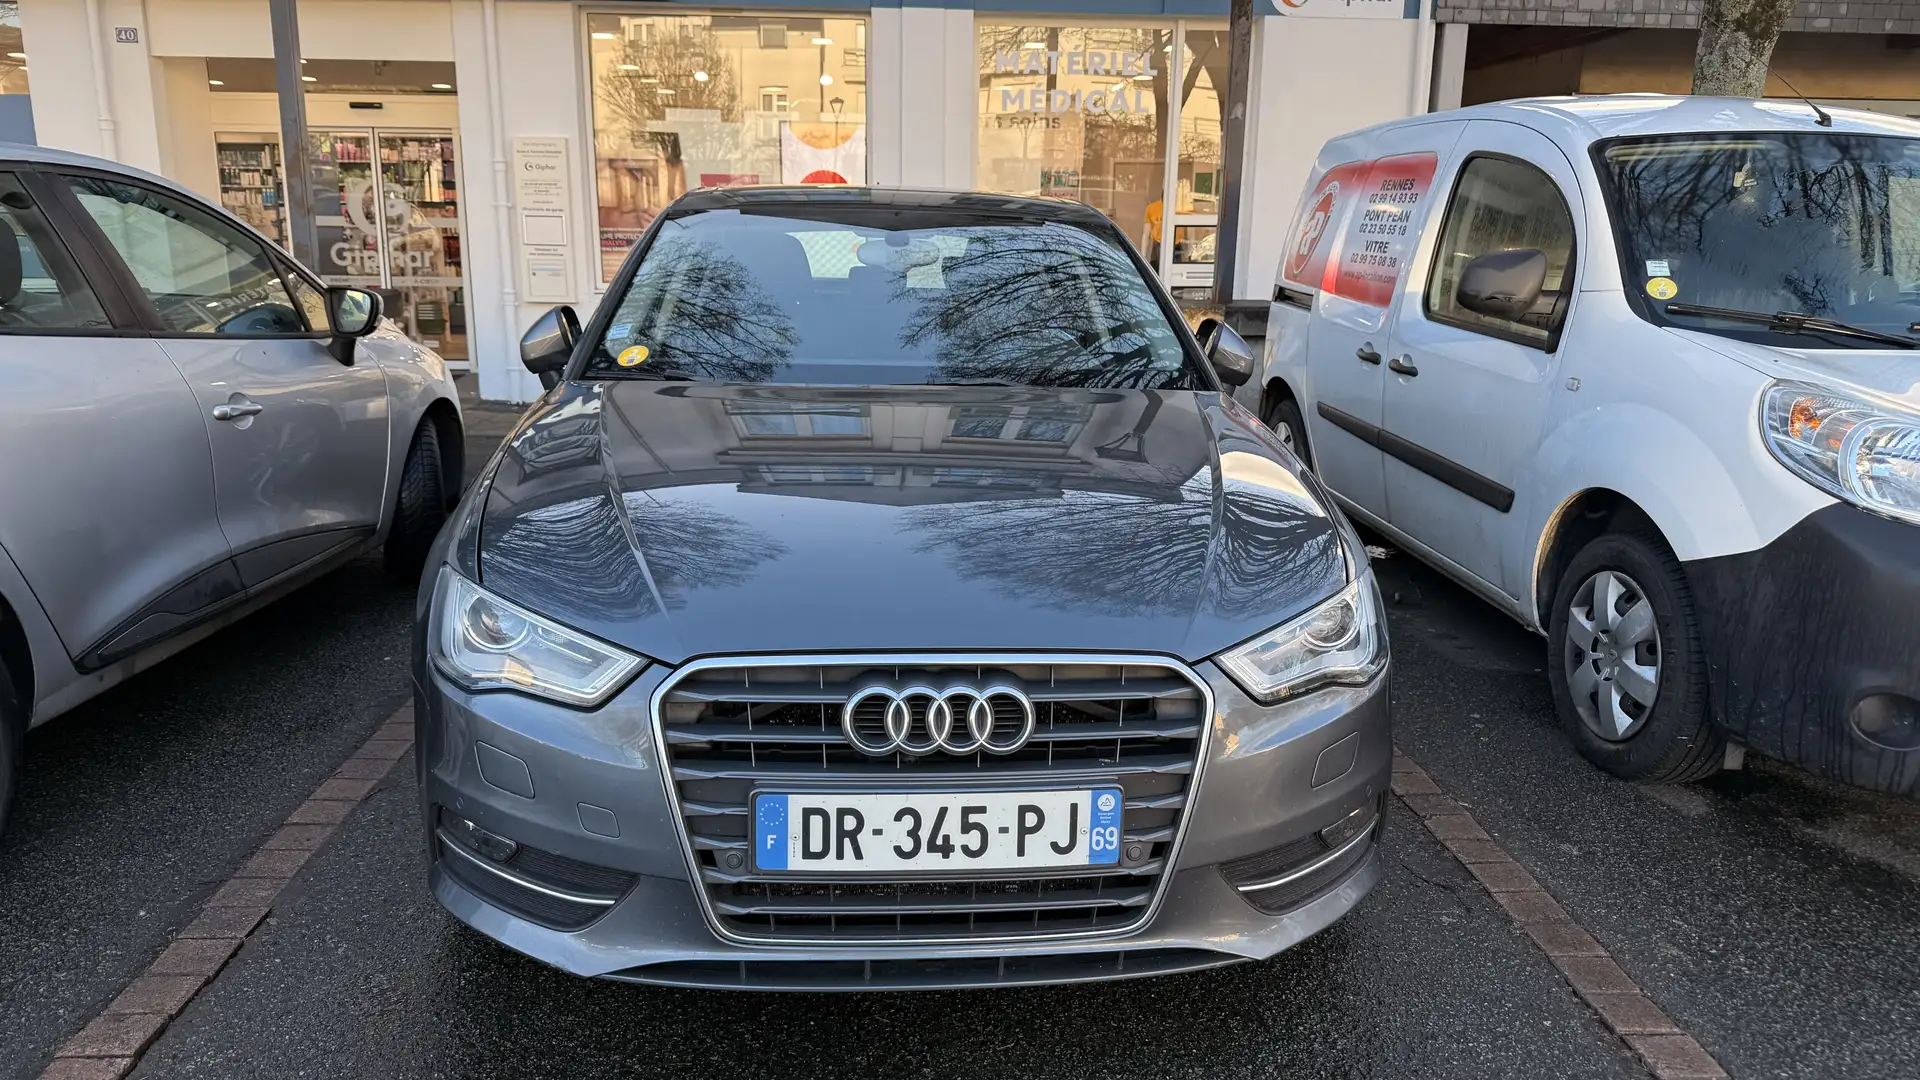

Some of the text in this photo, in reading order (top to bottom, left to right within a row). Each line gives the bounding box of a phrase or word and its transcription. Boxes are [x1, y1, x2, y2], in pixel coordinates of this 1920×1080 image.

[119, 30, 134, 40] 40
[995, 44, 1158, 77] MATÉRIEL
[1001, 82, 1150, 113] MÉDICAL
[1009, 112, 1061, 129] soins
[534, 163, 556, 171] Giphar
[1380, 179, 1416, 191] RENNES
[1369, 192, 1419, 204] 02 99 14 93 93
[1363, 209, 1387, 222] PONT
[1359, 222, 1408, 236] 02 23 50 55 18
[1365, 240, 1390, 254] VITRE
[1350, 252, 1397, 268] 02 99 75 08 38
[801, 802, 1079, 861] DR-345-PJ
[1091, 826, 1118, 851] 69
[767, 834, 776, 849] F
